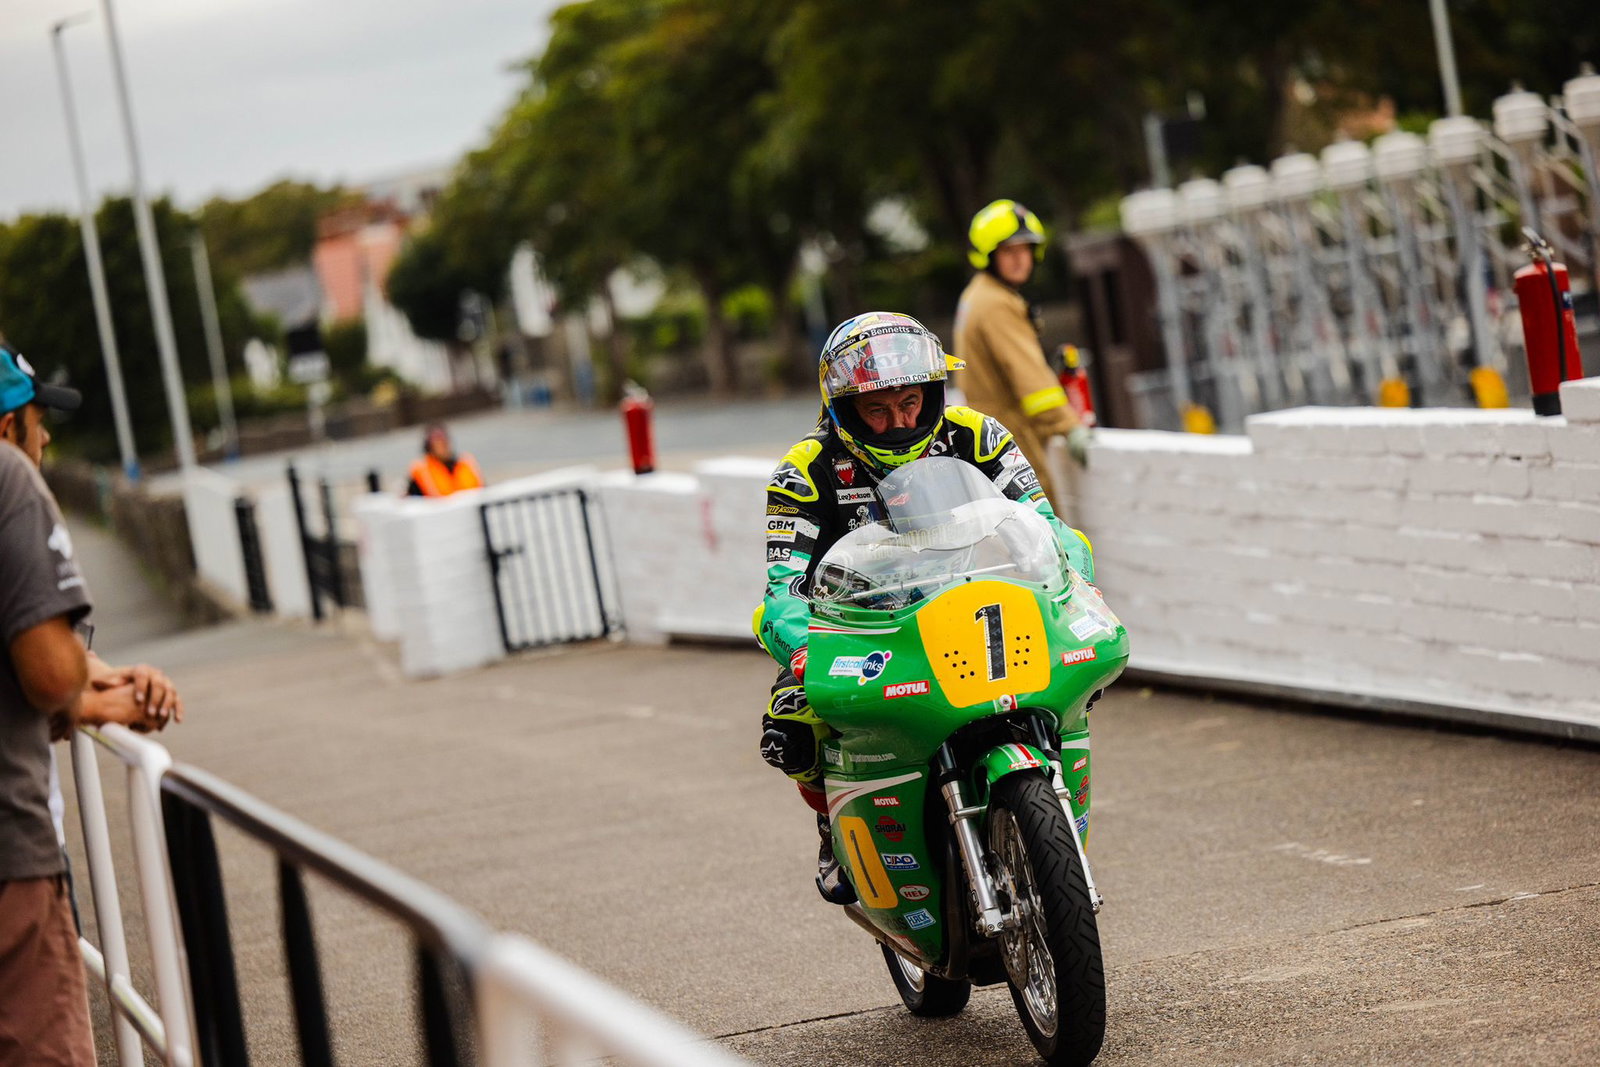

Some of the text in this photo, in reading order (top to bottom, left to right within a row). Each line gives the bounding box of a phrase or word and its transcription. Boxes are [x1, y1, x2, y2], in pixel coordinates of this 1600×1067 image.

[870, 326, 910, 337] Bennetts
[859, 373, 928, 393] REDTORPEDO.COM
[767, 520, 796, 531] GBM
[768, 547, 791, 559] BAS
[974, 603, 1008, 682] 1
[1063, 649, 1096, 665] MOTUL
[885, 682, 928, 698] MOTUL
[873, 797, 900, 807] MOTUL
[903, 890, 927, 899] HEL
